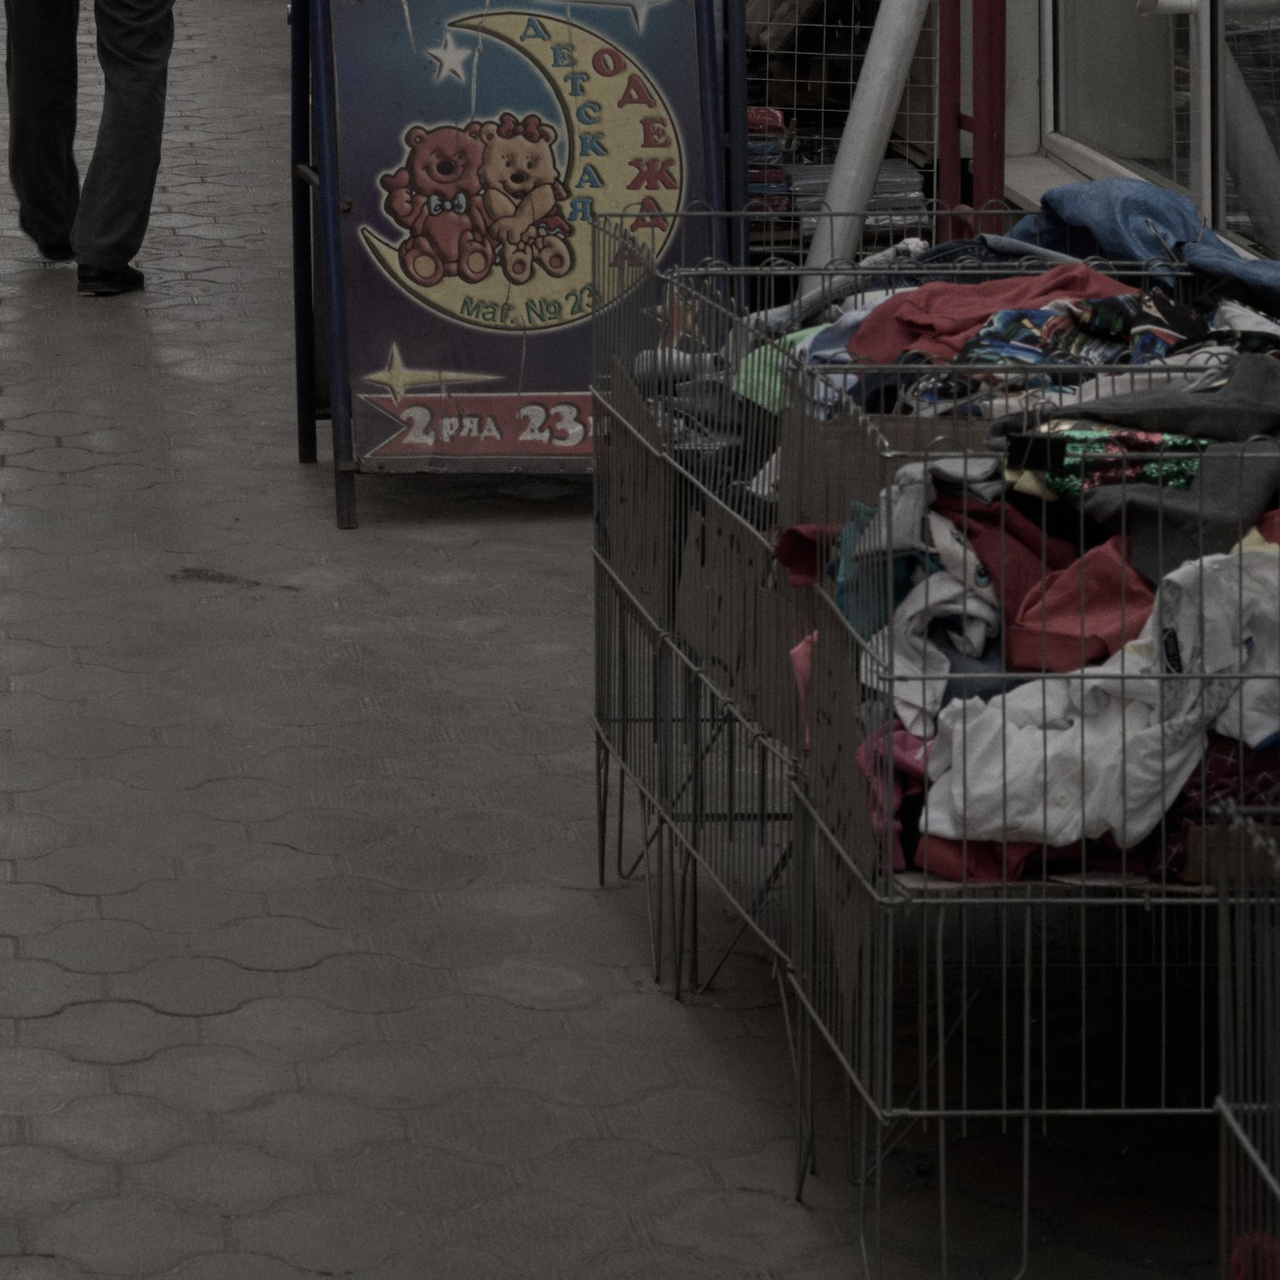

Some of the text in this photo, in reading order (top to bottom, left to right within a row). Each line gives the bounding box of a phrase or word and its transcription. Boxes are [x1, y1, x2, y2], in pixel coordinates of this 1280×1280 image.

[520, 16, 609, 222] ДЕТСКАЯ
[564, 284, 596, 316] 23
[402, 405, 436, 447] 2
[517, 404, 586, 447] 23
